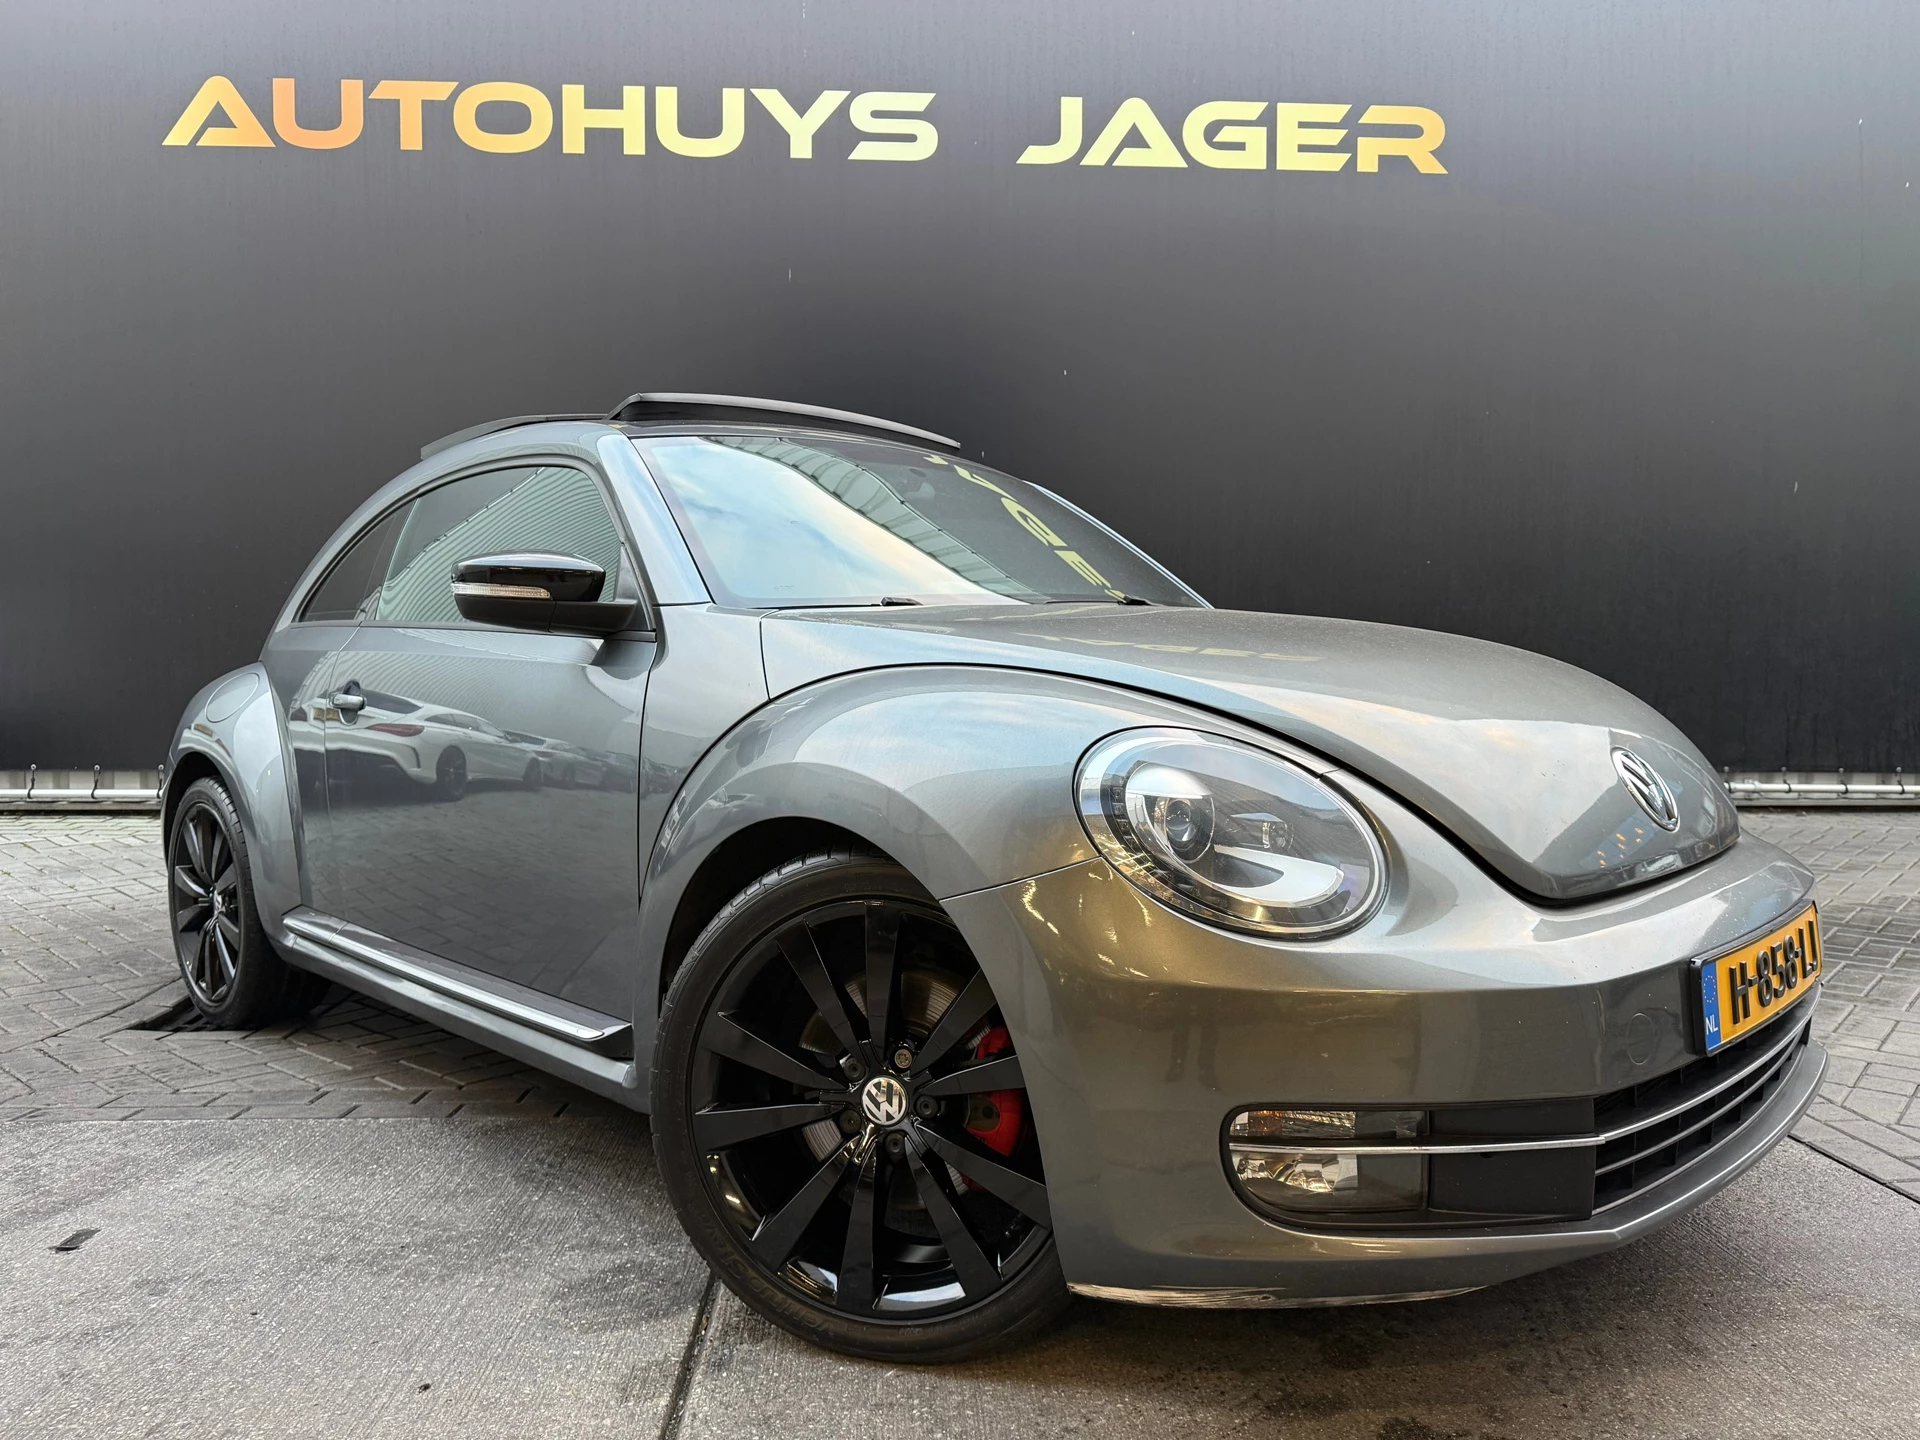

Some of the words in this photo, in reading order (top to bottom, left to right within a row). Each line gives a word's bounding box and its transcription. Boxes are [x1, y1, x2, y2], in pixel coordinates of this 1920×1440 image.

[162, 75, 940, 162] AUTOHUYS
[1016, 96, 1449, 175] JAGER
[1729, 919, 1819, 1025] H-858-LJ
[1705, 1014, 1719, 1036] NL
